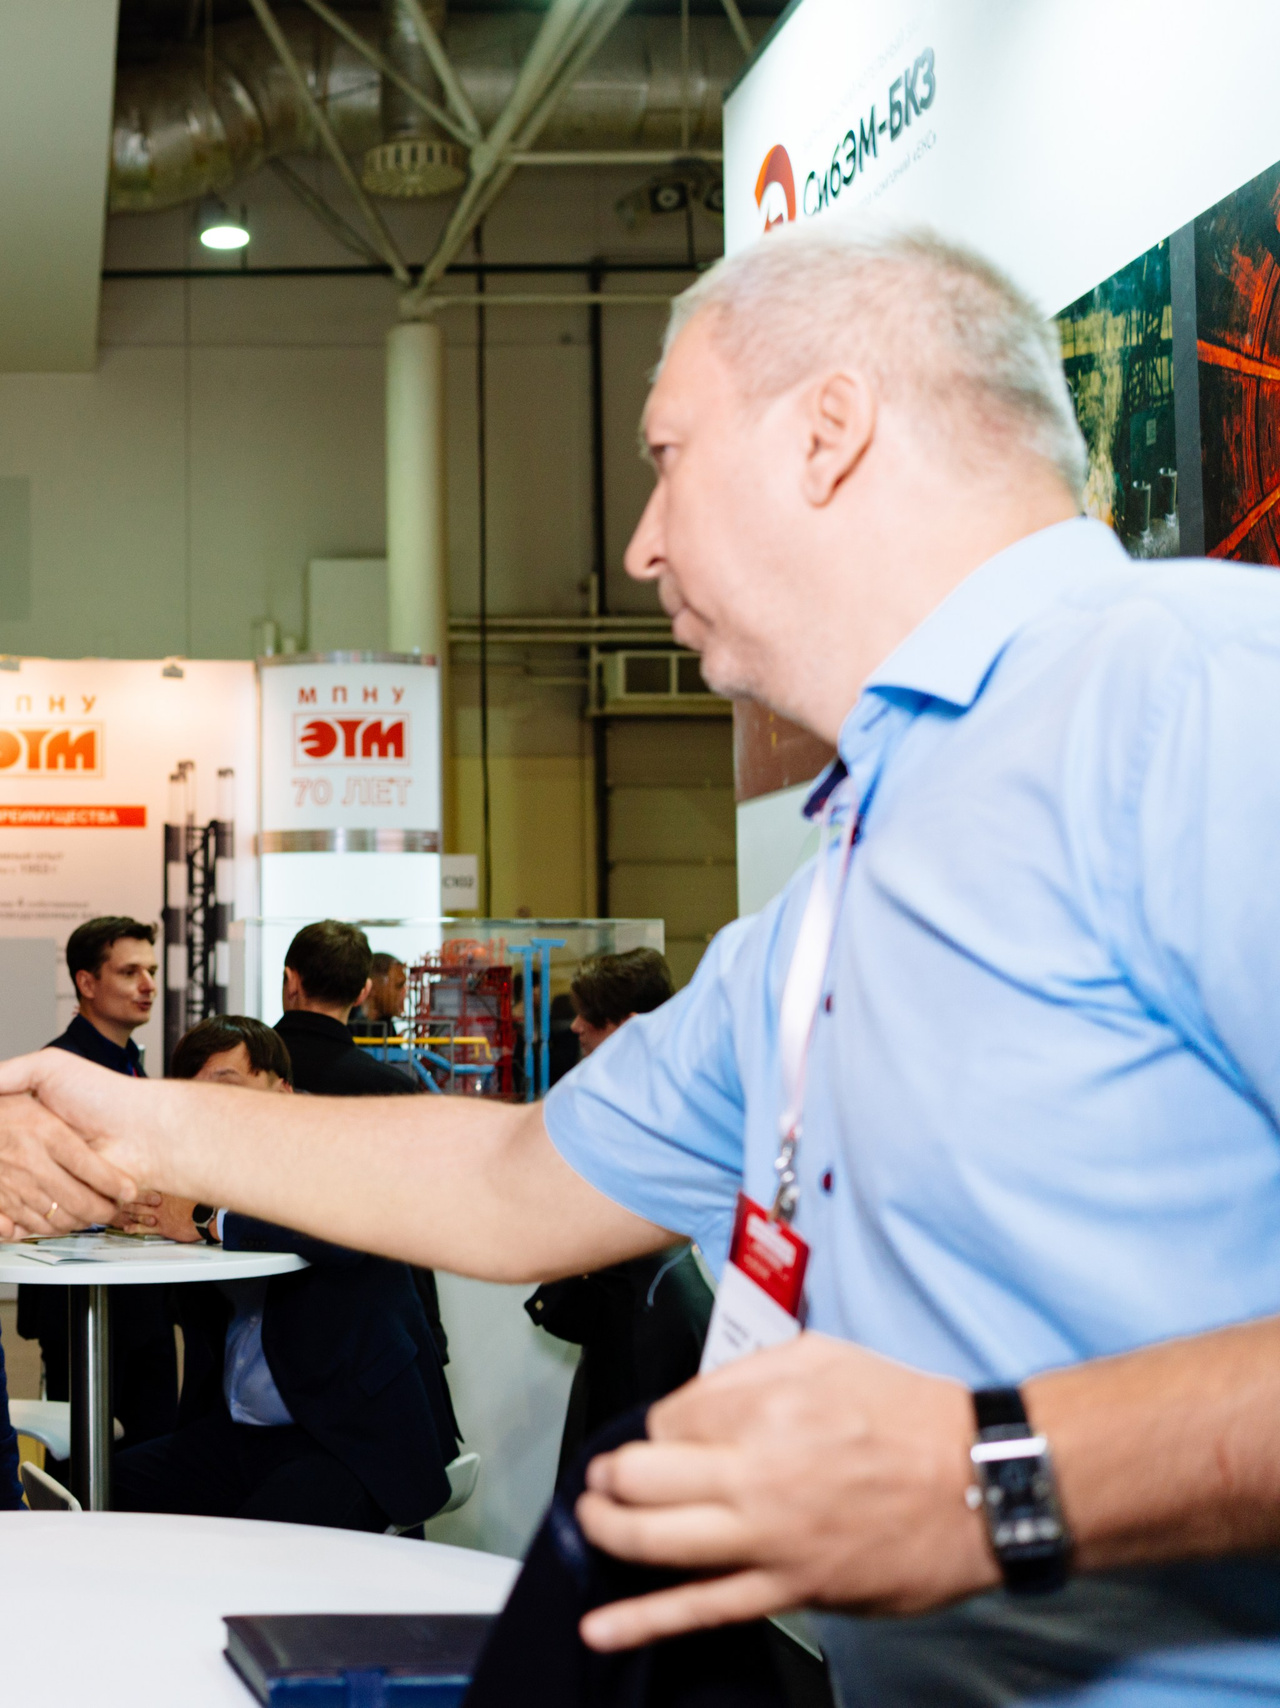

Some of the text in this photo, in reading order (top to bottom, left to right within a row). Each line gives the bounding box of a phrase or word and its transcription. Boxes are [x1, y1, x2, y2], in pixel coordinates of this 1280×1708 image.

[803, 46, 936, 217] СибЭМ-БКЗ
[298, 686, 404, 704] МПНУ
[300, 720, 405, 758] ЭТМ
[291, 778, 412, 806] 70 ЛЕТ
